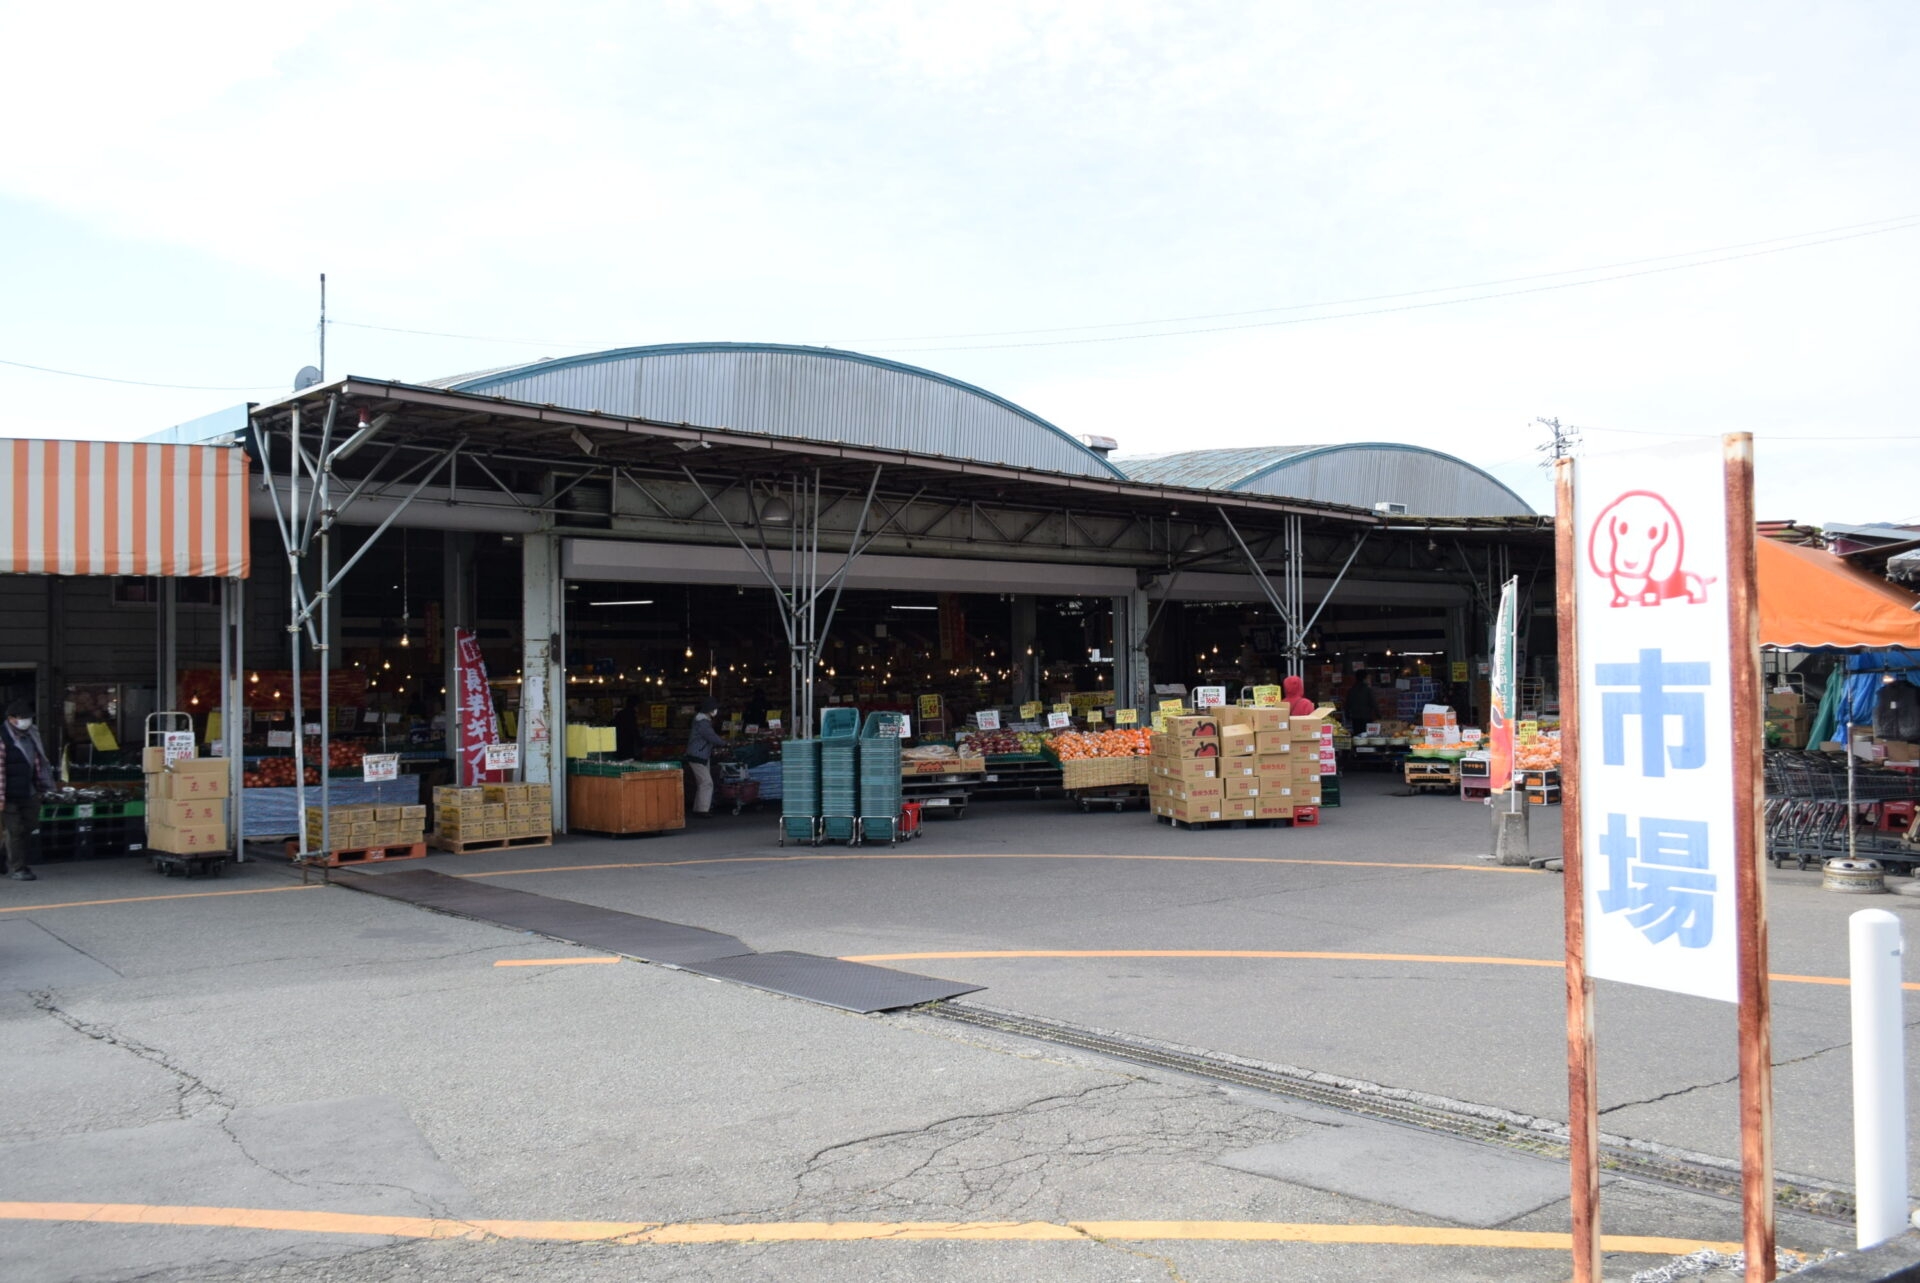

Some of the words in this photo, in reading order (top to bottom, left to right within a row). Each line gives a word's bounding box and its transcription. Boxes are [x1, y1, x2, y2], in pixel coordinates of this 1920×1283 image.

[465, 667, 487, 787] 長芋ギフト
[1595, 648, 1717, 949] 市場
